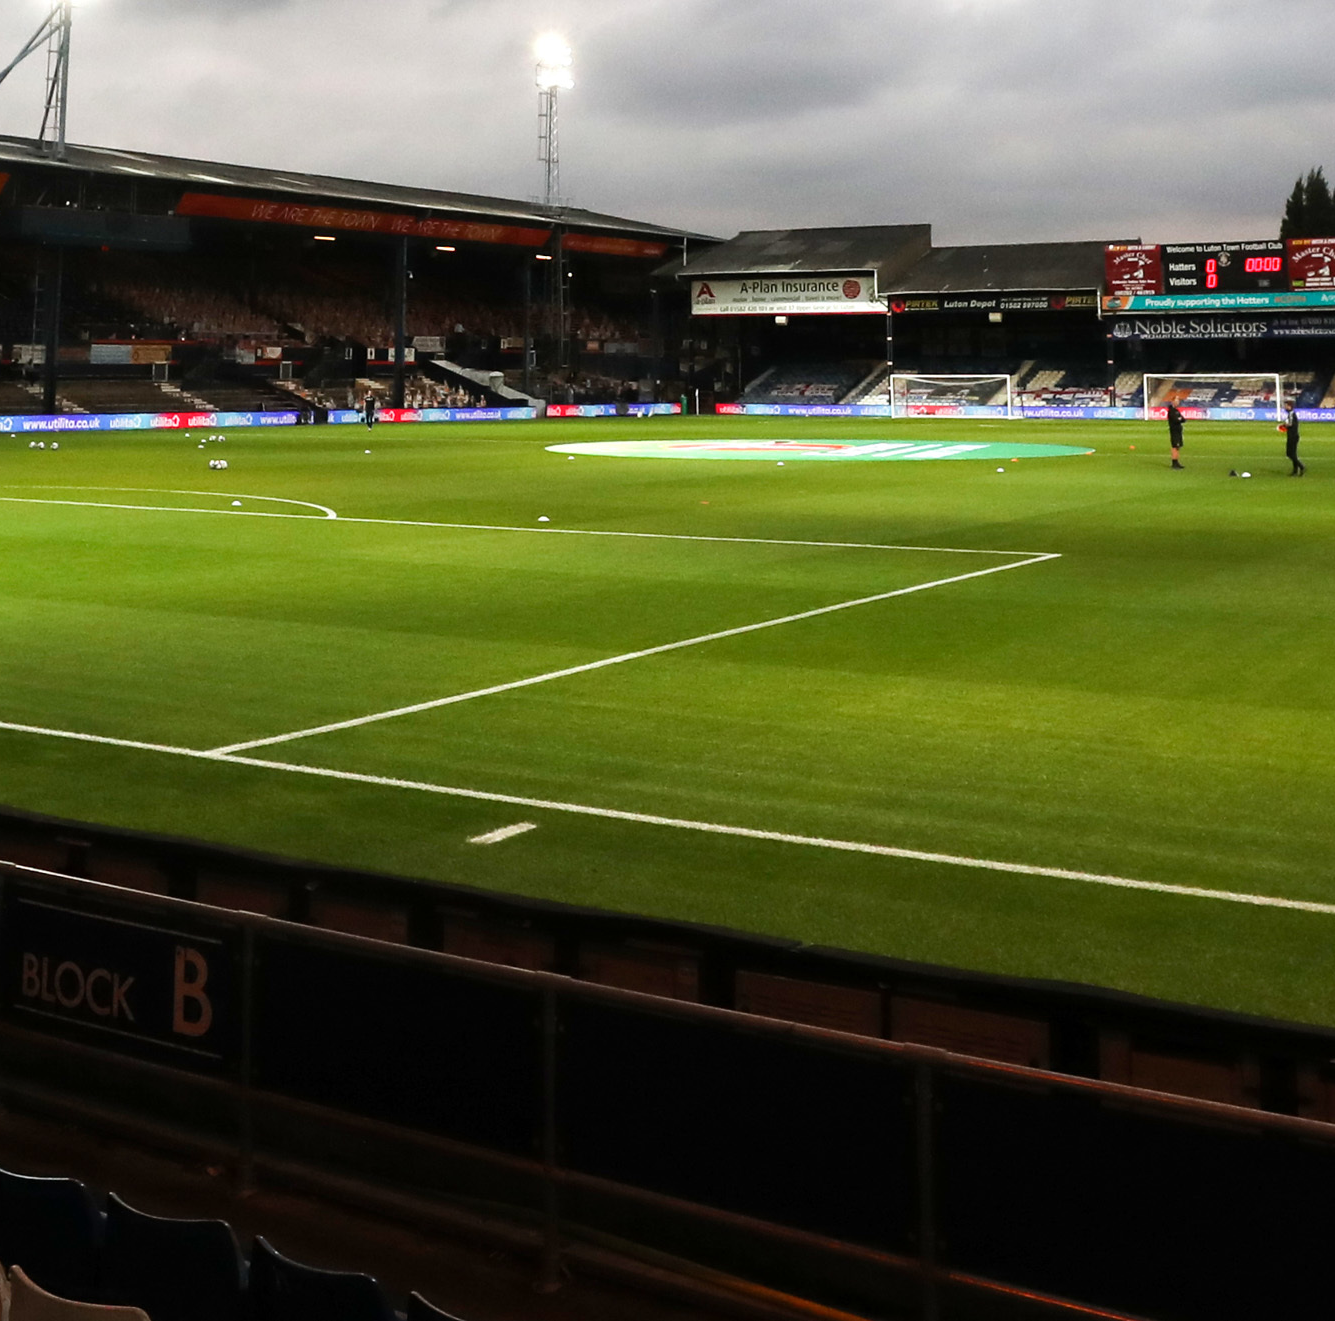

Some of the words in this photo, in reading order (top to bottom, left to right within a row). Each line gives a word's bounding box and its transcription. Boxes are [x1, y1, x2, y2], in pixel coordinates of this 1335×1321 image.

[250, 203, 278, 220] WE
[278, 206, 309, 223] ARE
[310, 209, 338, 225] THE
[338, 212, 382, 230] TOWN
[1166, 245, 1195, 254] Welcome
[1196, 245, 1203, 253] to
[1203, 243, 1221, 253] Luton
[1222, 242, 1240, 252] Town
[1241, 241, 1266, 251] Football
[1267, 241, 1283, 250] Club
[1291, 246, 1321, 263] Master
[1113, 251, 1136, 265] Master
[1135, 251, 1153, 265] Chef
[1168, 262, 1197, 272] Hatters
[1206, 258, 1217, 274] 0
[740, 280, 778, 294] A-Plan
[781, 280, 839, 294] Insurance
[1168, 277, 1197, 287] Visitors
[1206, 273, 1218, 289] 0
[905, 299, 939, 308] PIRTEK
[944, 299, 968, 309] Luton
[969, 298, 996, 309] Depot
[1145, 297, 1175, 308] Proudly
[1176, 297, 1220, 308] supporting
[1221, 296, 1234, 305] the
[1236, 295, 1270, 306] Hatters
[1133, 319, 1186, 335] Noble
[1189, 318, 1268, 335] Solicitors
[188, 412, 212, 427] utilita
[787, 406, 853, 418] www.utilita.co.uk
[22, 414, 101, 431] www.utilita.co.uk
[109, 414, 135, 429] utilita
[150, 413, 174, 428] utilita
[21, 951, 137, 1022] BLOCK
[172, 945, 214, 1037] B
